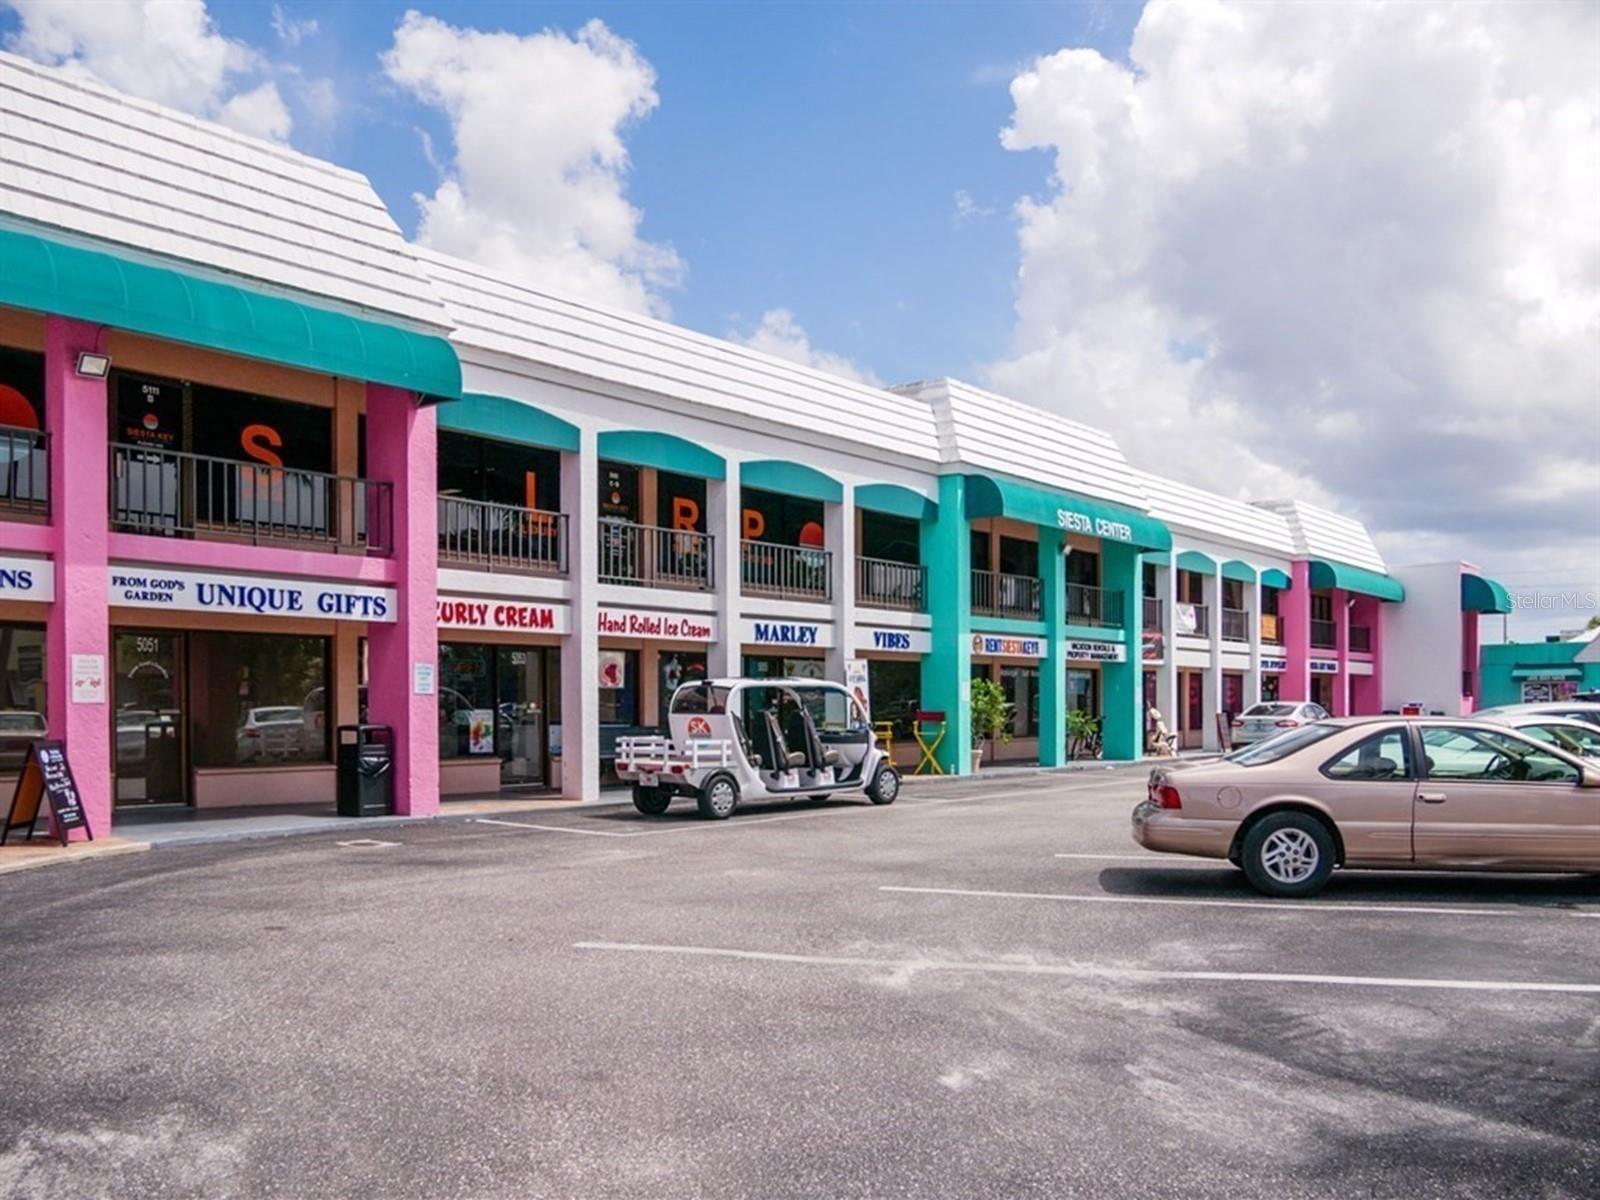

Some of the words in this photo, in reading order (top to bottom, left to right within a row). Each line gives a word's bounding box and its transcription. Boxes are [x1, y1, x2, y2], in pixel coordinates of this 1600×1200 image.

[526, 471, 554, 523] L
[673, 497, 699, 544] R
[743, 508, 765, 549] P
[1057, 509, 1093, 532] SIESTA
[1096, 517, 1133, 542] CENTER
[112, 576, 147, 587] FROM
[150, 579, 185, 590] GOD'S
[124, 590, 174, 602] GARDEN
[196, 583, 303, 613] UNIQUE
[317, 593, 387, 616] GIFTS
[494, 605, 554, 629] CREAM
[598, 612, 626, 632] Hand
[629, 615, 661, 635] Rolled
[664, 618, 679, 636] Ice
[681, 619, 711, 637] Cream
[754, 623, 818, 644] MARLEY
[873, 631, 911, 649] VIBES
[690, 721, 710, 733] SK
